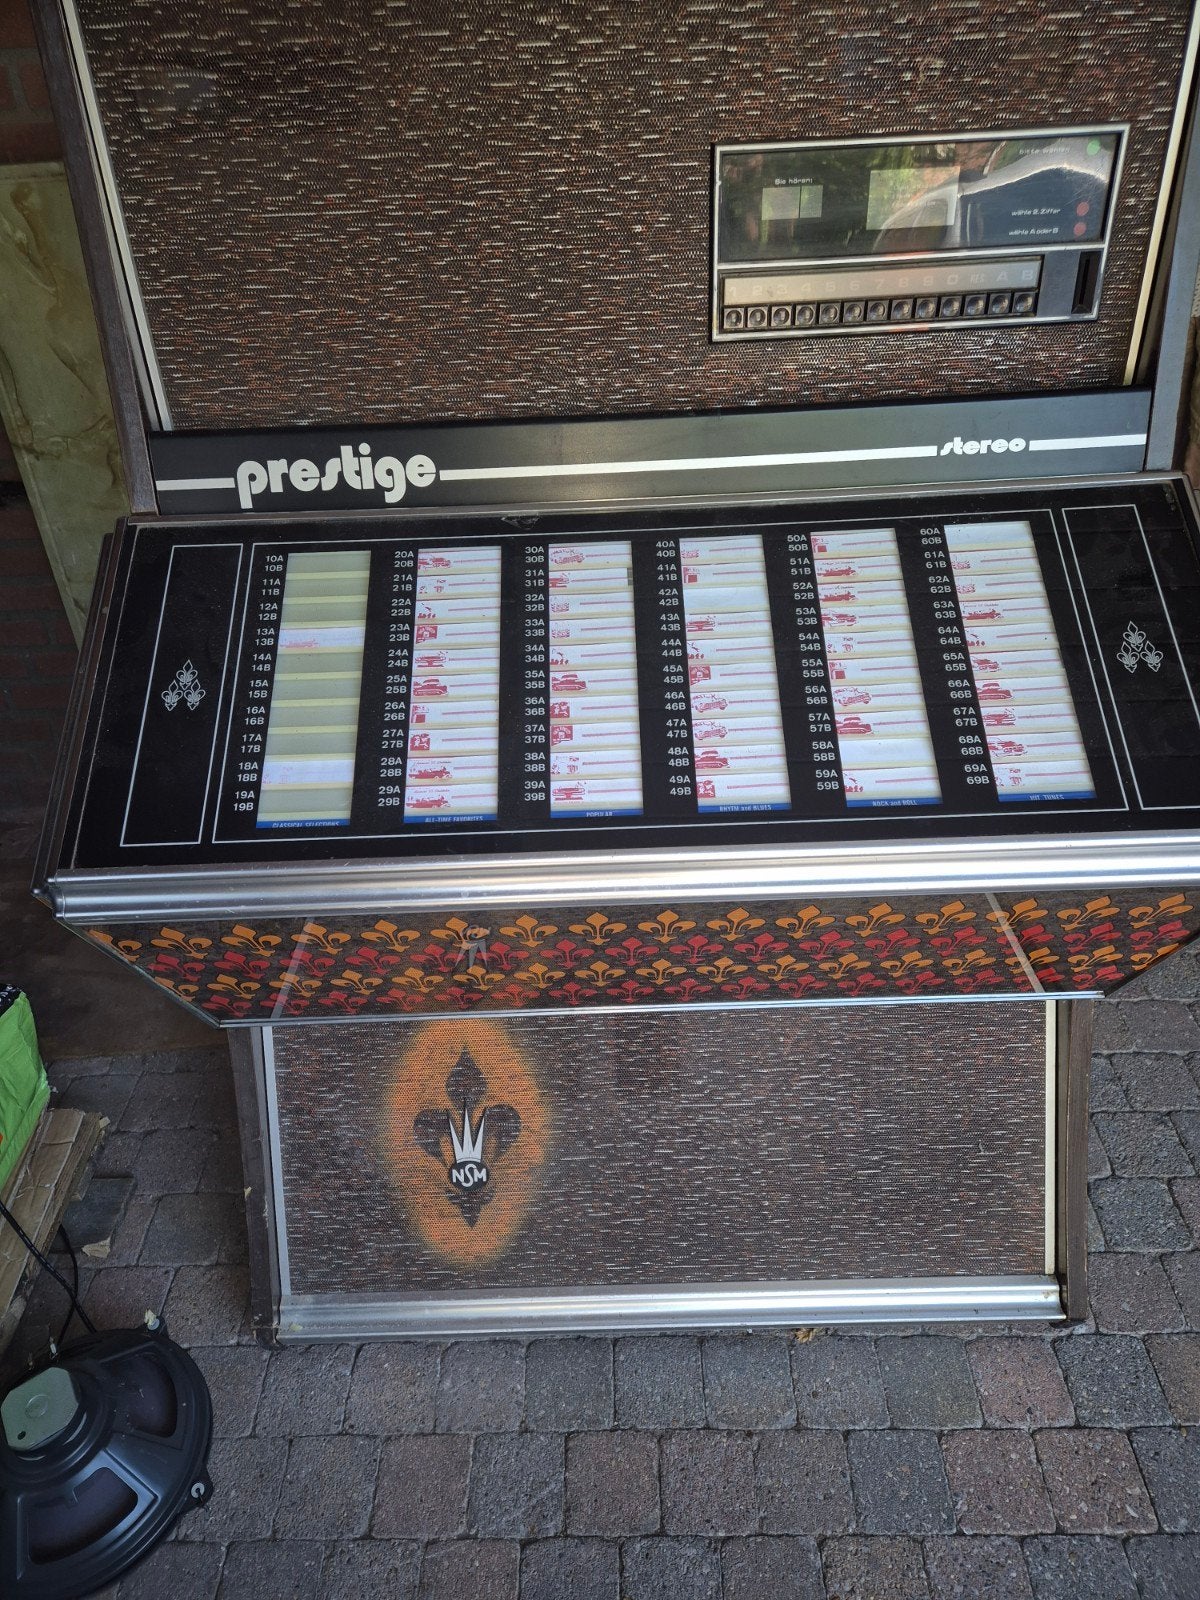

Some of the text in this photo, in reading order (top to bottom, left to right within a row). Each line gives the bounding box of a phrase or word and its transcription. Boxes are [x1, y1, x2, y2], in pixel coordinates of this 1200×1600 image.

[940, 437, 1026, 456] stereo
[237, 442, 436, 508] prestige
[526, 555, 544, 563] 30B
[793, 582, 813, 590] 52A
[794, 592, 814, 600] 52B
[659, 598, 679, 606] 42B
[796, 607, 816, 615] 53A
[660, 613, 680, 621] 43A
[938, 626, 959, 634] 64A
[525, 644, 545, 652] 34A
[800, 643, 821, 651] 54B
[662, 649, 682, 657] 44B
[945, 663, 966, 671] 65B
[525, 670, 545, 678] 35A
[803, 670, 824, 678] 55B
[387, 675, 407, 683] 25A
[948, 679, 970, 687] 66A
[525, 681, 545, 689] 35B
[805, 685, 827, 693] 56A
[249, 690, 267, 698] 15B
[386, 686, 406, 694] 25B
[950, 690, 972, 698] 66B
[665, 691, 685, 699] 46A
[525, 697, 545, 705] 36A
[247, 706, 265, 714] 16A
[385, 702, 405, 710] 26A
[665, 702, 686, 710] 46B
[953, 707, 975, 715] 67A
[245, 717, 264, 725] 16B
[384, 713, 405, 721] 26B
[809, 713, 830, 721] 57A
[955, 718, 977, 726] 67B
[525, 724, 545, 732] 37A
[810, 724, 831, 732] 57B
[383, 729, 404, 737] 27A
[667, 730, 687, 738] 47B
[243, 734, 262, 742] 17A
[525, 735, 545, 743] 37B
[959, 735, 981, 743] 68A
[382, 740, 403, 748] 27B
[812, 741, 834, 749] 58A
[241, 745, 260, 753] 17B
[668, 747, 689, 755] 48A
[961, 747, 983, 755] 68B
[525, 752, 545, 760] 38A
[814, 753, 835, 761] 58B
[381, 757, 402, 765] 28A
[669, 758, 689, 766] 48B
[239, 762, 258, 770] 18A
[525, 764, 545, 772] 38B
[964, 764, 987, 772] 69A
[238, 773, 257, 781] 18B
[380, 769, 402, 777] 28B
[816, 769, 837, 778] 59A
[669, 775, 690, 783] 49A
[967, 776, 989, 784] 69B
[525, 781, 545, 789] 39A
[817, 781, 838, 790] 59B
[379, 785, 400, 794] 29A
[670, 787, 691, 795] 49B
[235, 791, 254, 799] 19A
[525, 792, 545, 801] 39B
[378, 797, 400, 806] 29B
[234, 802, 253, 811] 19B
[452, 1164, 487, 1187] NSM
